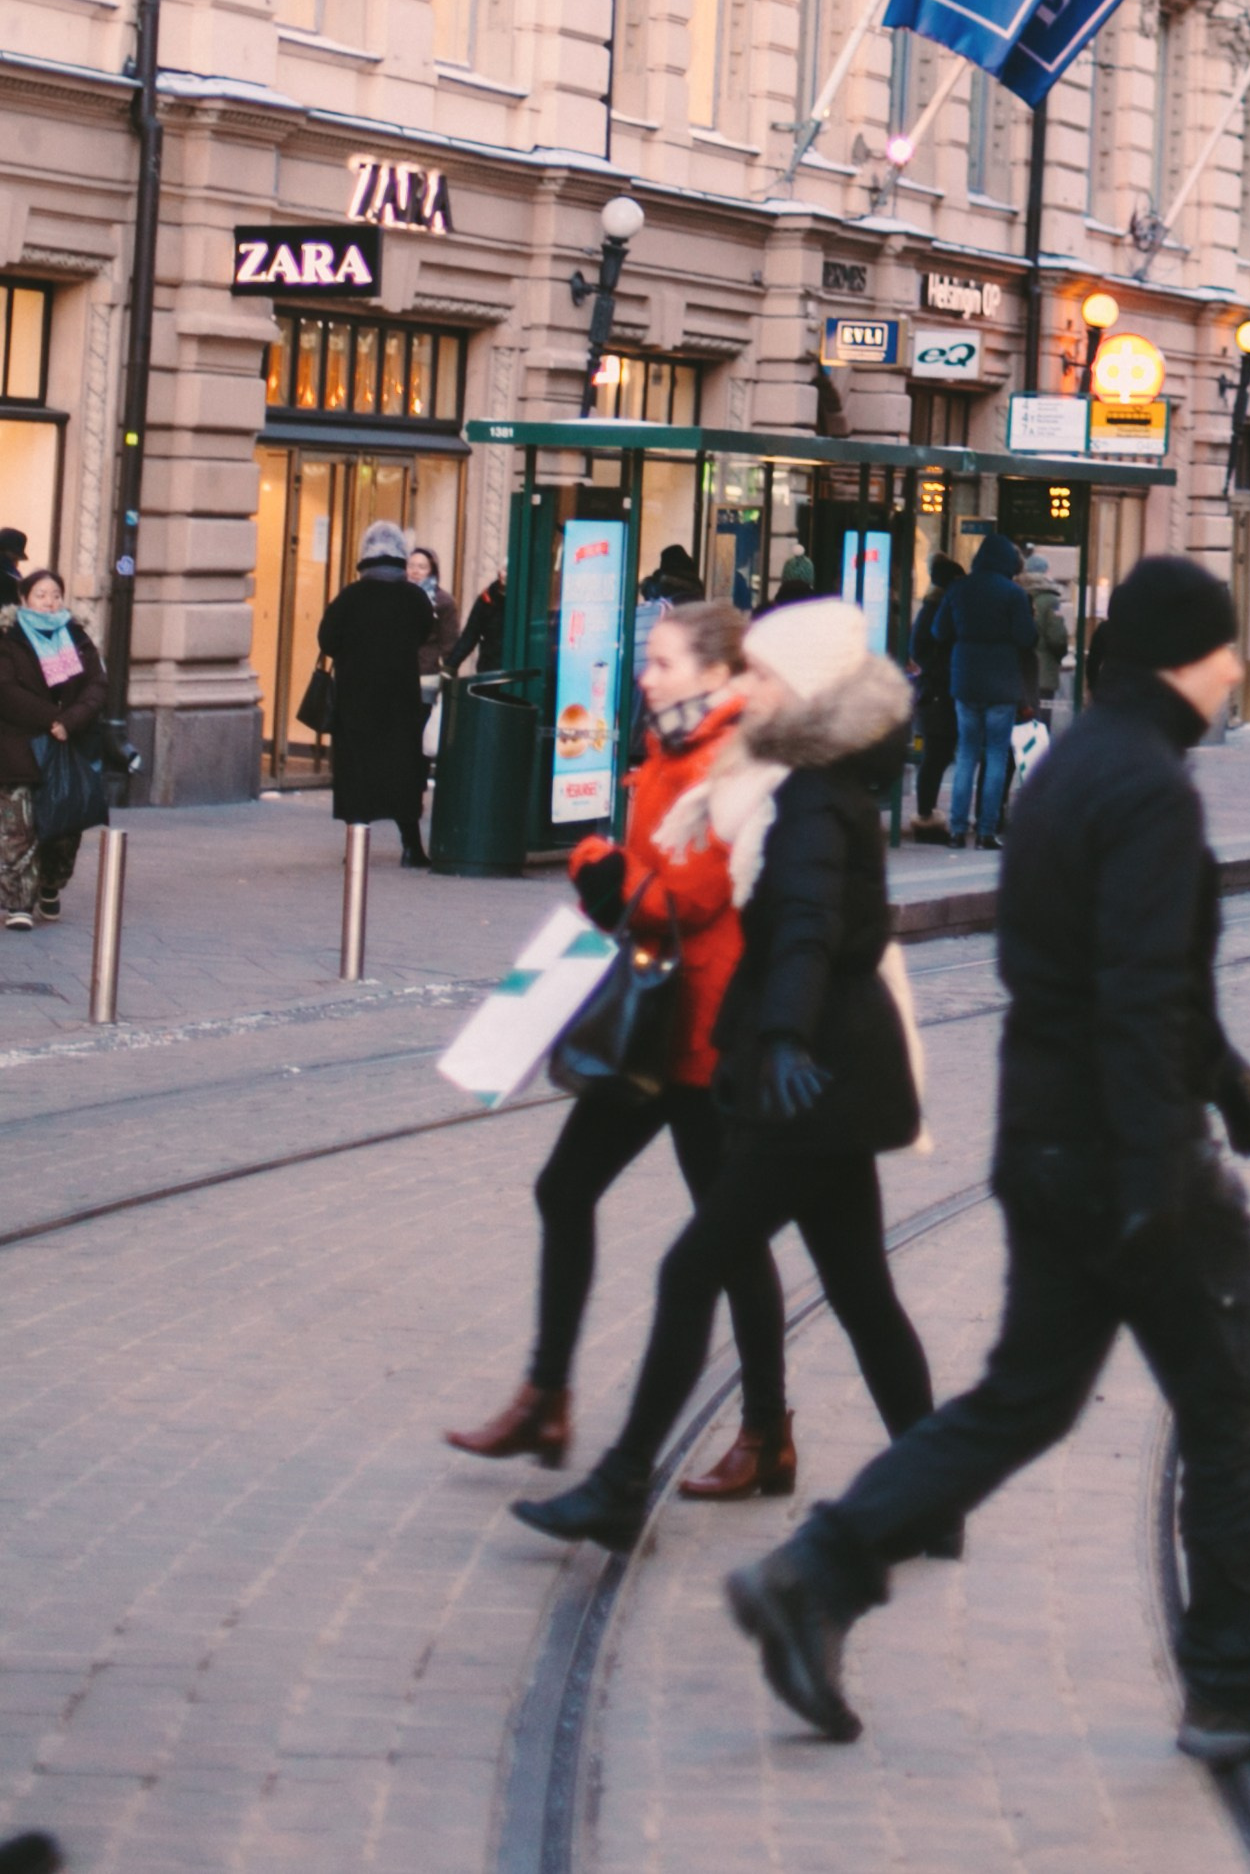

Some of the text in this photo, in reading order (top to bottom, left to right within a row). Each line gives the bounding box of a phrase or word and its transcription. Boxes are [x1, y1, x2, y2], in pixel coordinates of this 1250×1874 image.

[348, 151, 454, 234] ZARA
[236, 240, 373, 285] ZARA
[842, 326, 884, 345] EVLI
